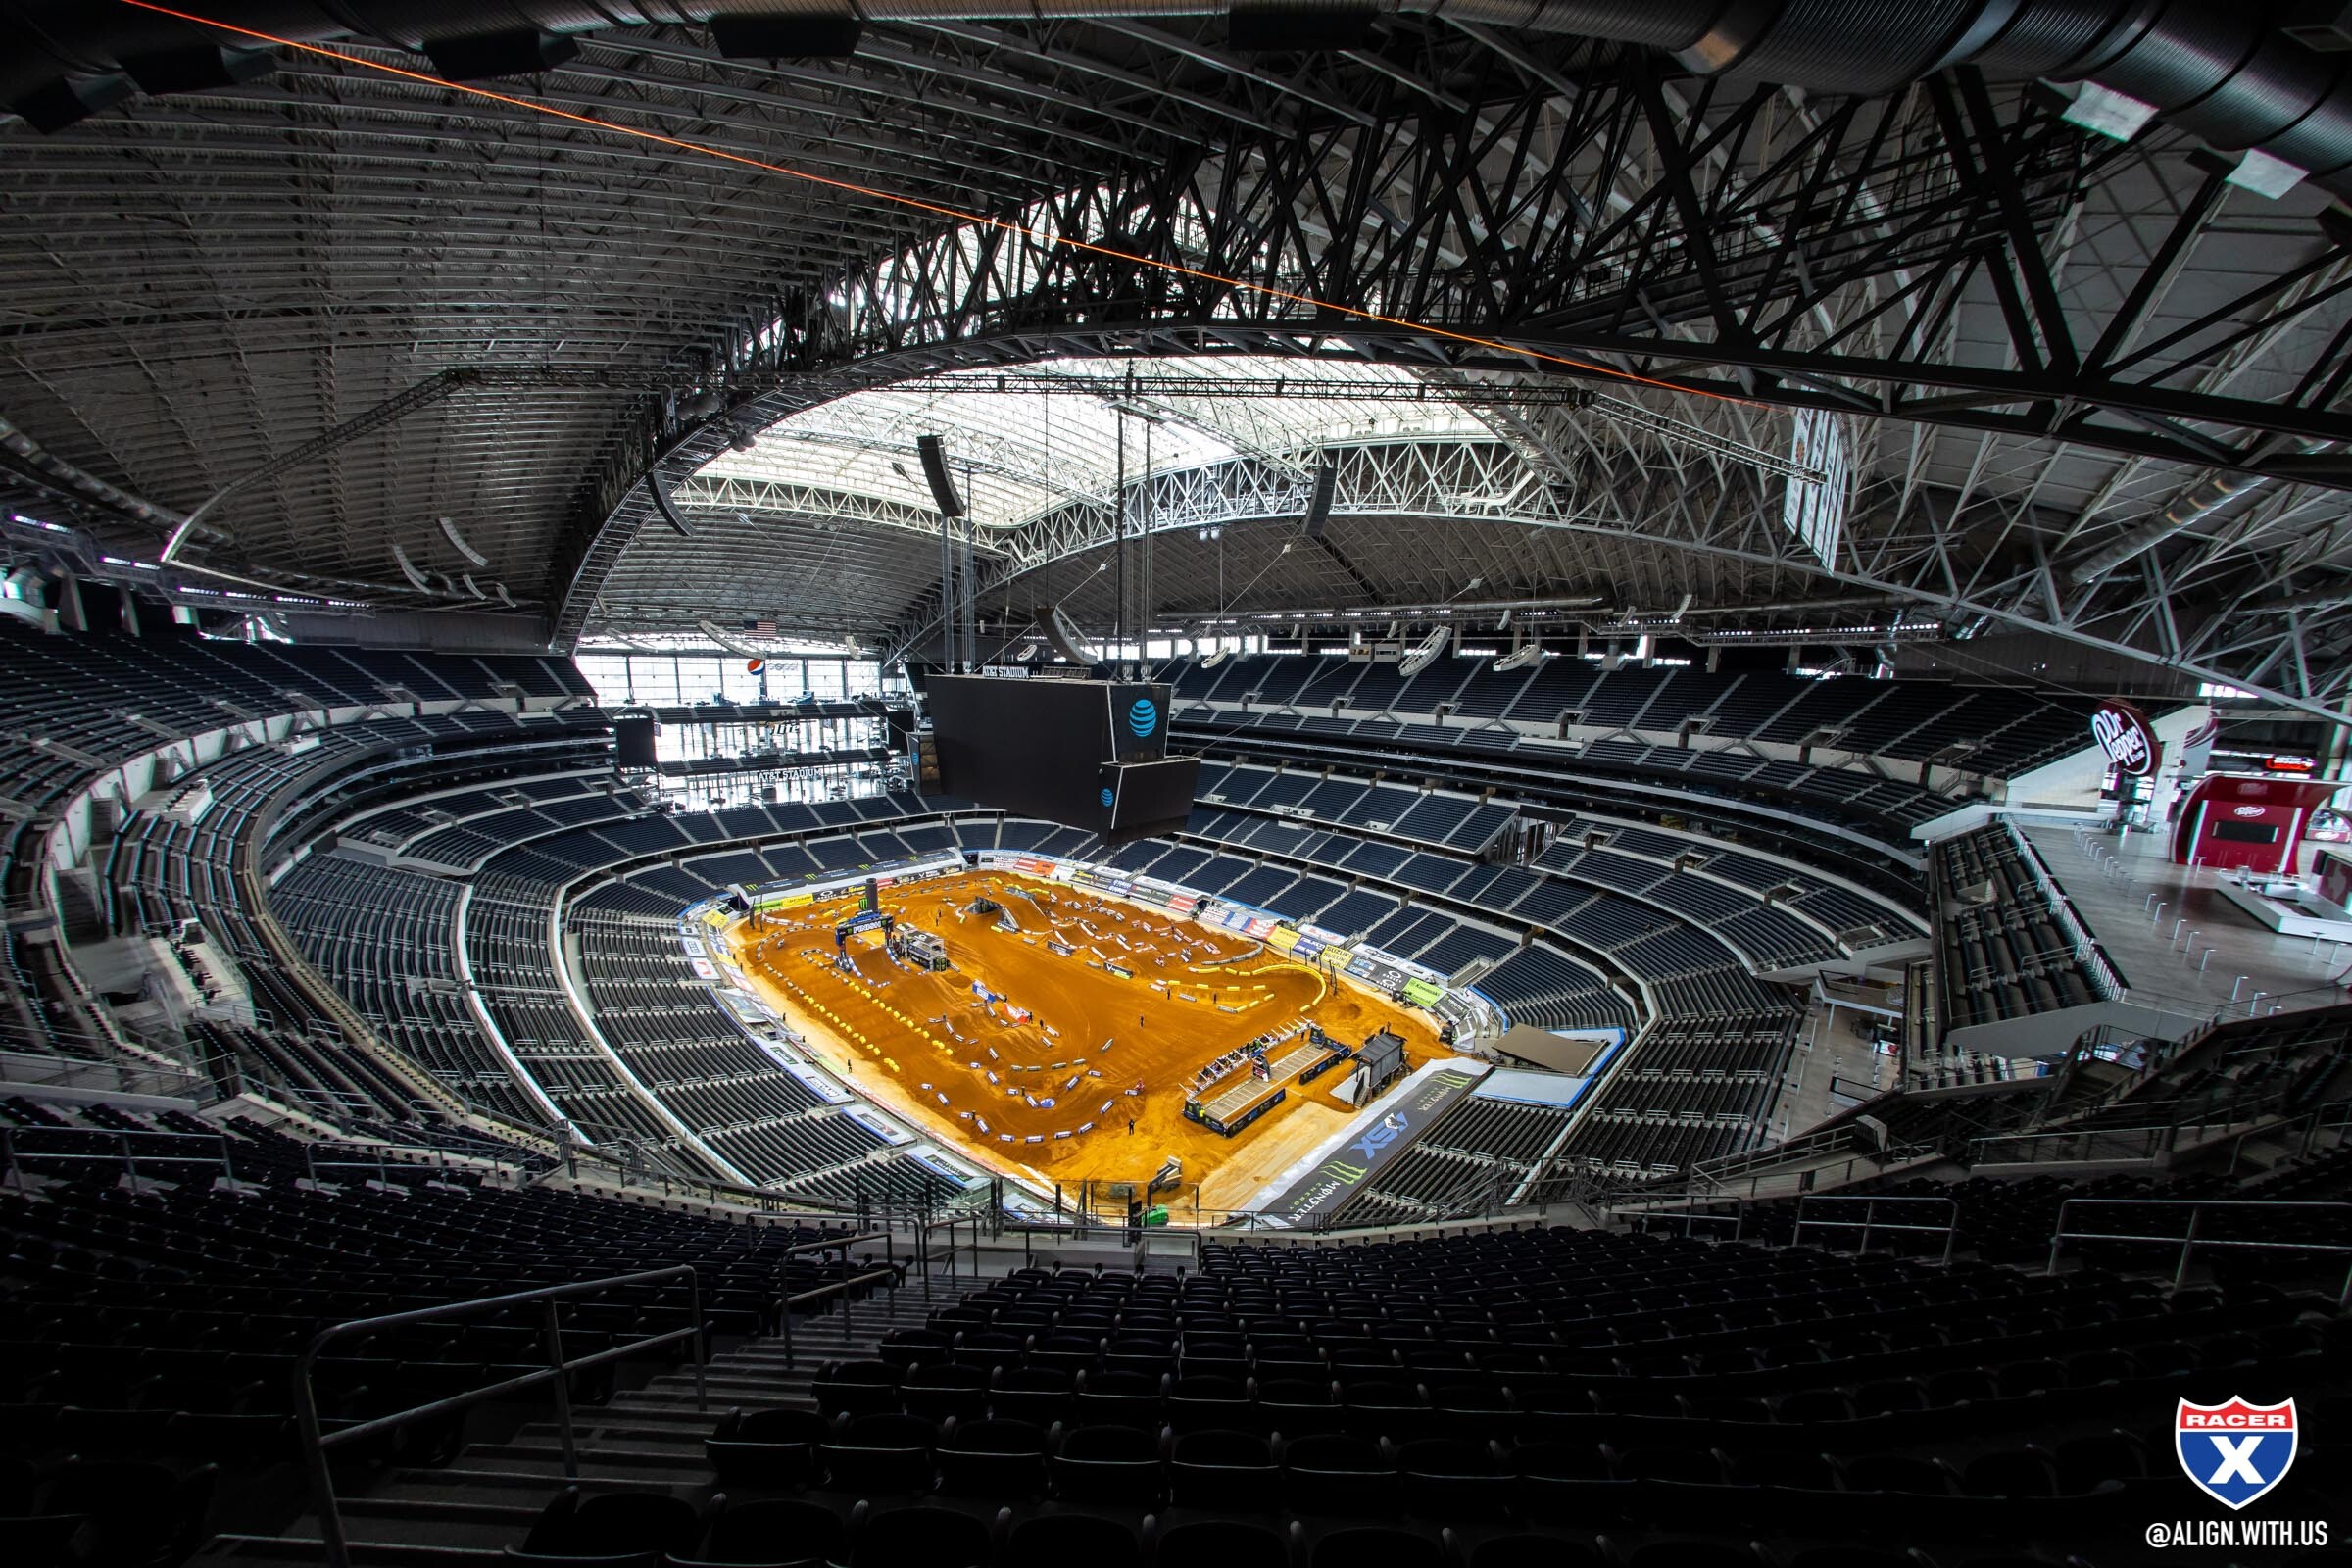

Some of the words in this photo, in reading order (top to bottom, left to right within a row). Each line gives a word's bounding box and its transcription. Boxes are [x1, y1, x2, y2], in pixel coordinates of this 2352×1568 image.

[983, 666, 998, 677] AT&T
[999, 666, 1030, 678] STADIUM
[2100, 709, 2125, 739] Dr
[2091, 713, 2144, 766] Pepper
[758, 771, 782, 783] AT&T
[783, 767, 822, 779] STADIUM
[853, 920, 882, 934] FINISH
[1323, 952, 1348, 964] SUZUKI
[1326, 946, 1352, 958] SUZUKI
[1418, 1086, 1452, 1111] MONSTER
[1288, 1180, 1342, 1222] MONSTER
[1290, 1182, 1323, 1211] ENERGY
